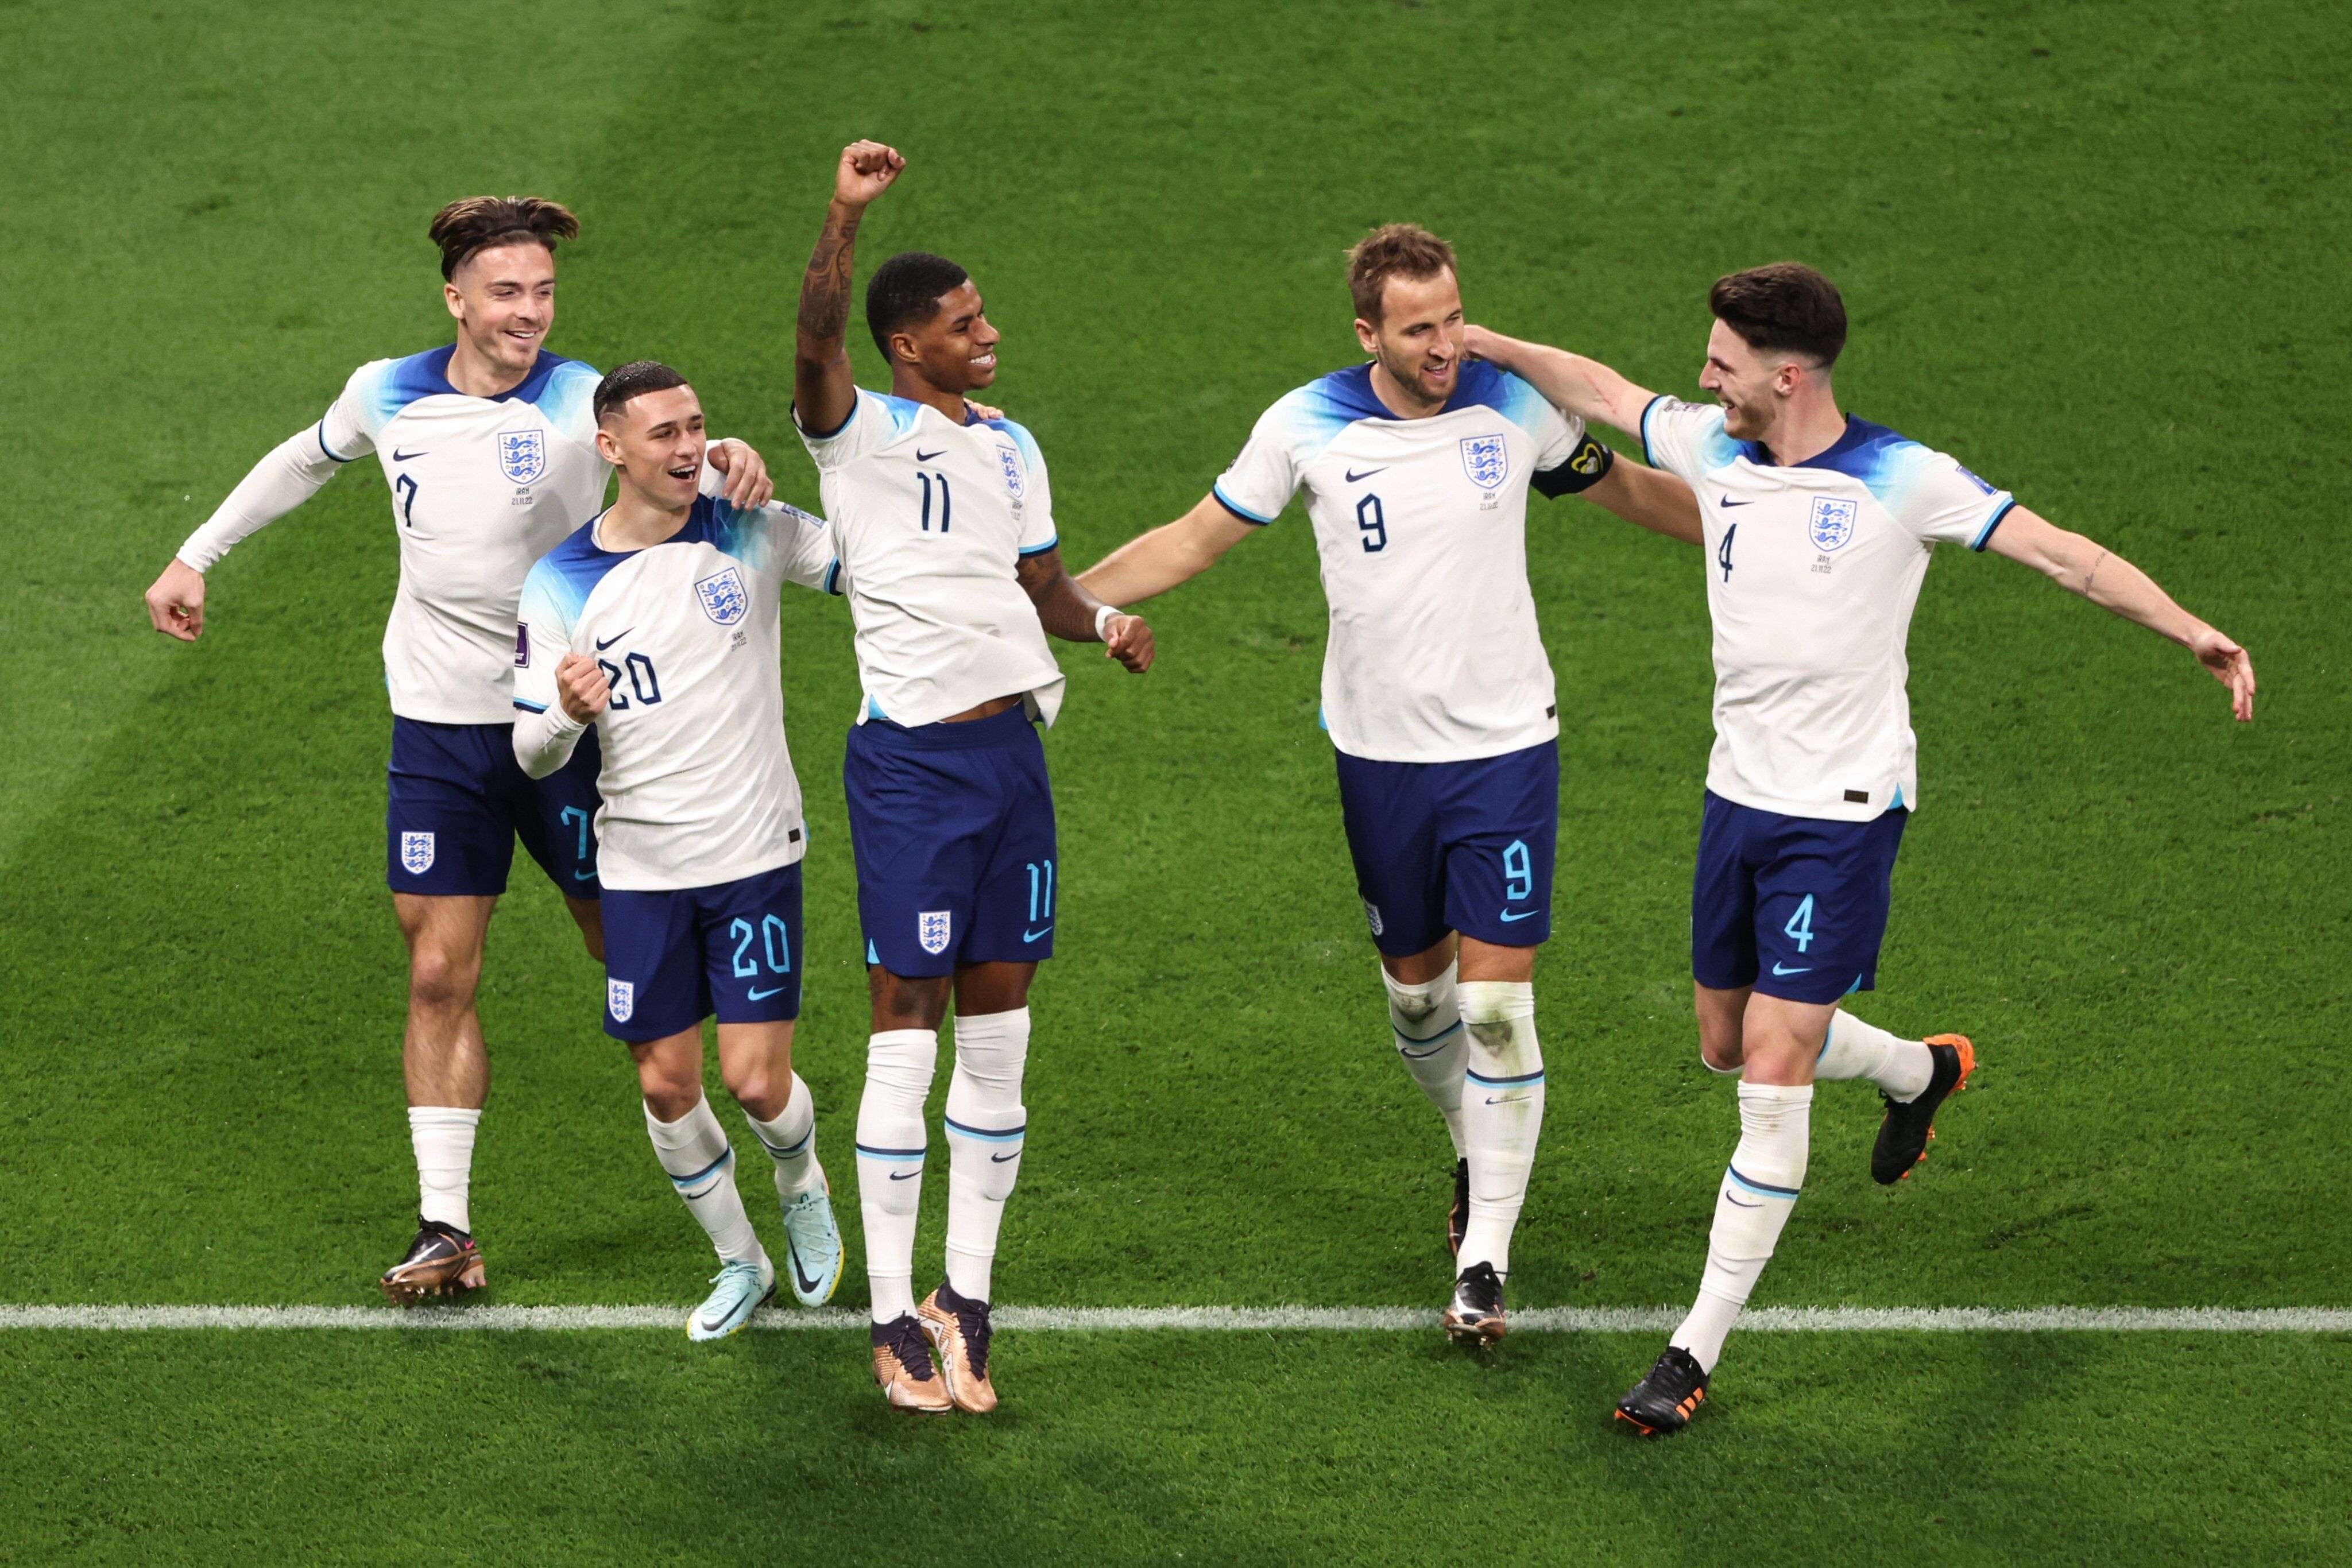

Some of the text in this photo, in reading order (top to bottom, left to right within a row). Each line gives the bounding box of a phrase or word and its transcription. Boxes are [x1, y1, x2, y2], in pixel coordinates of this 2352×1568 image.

[396, 473, 418, 528] 7
[917, 472, 950, 533] 11
[1357, 493, 1387, 552] 9
[1719, 523, 1737, 583] 4
[598, 652, 662, 710] 20
[560, 806, 587, 860] 7
[1026, 860, 1053, 922] 11
[1502, 839, 1532, 900] 9
[730, 913, 790, 978] 20
[1784, 893, 1814, 953] 4
